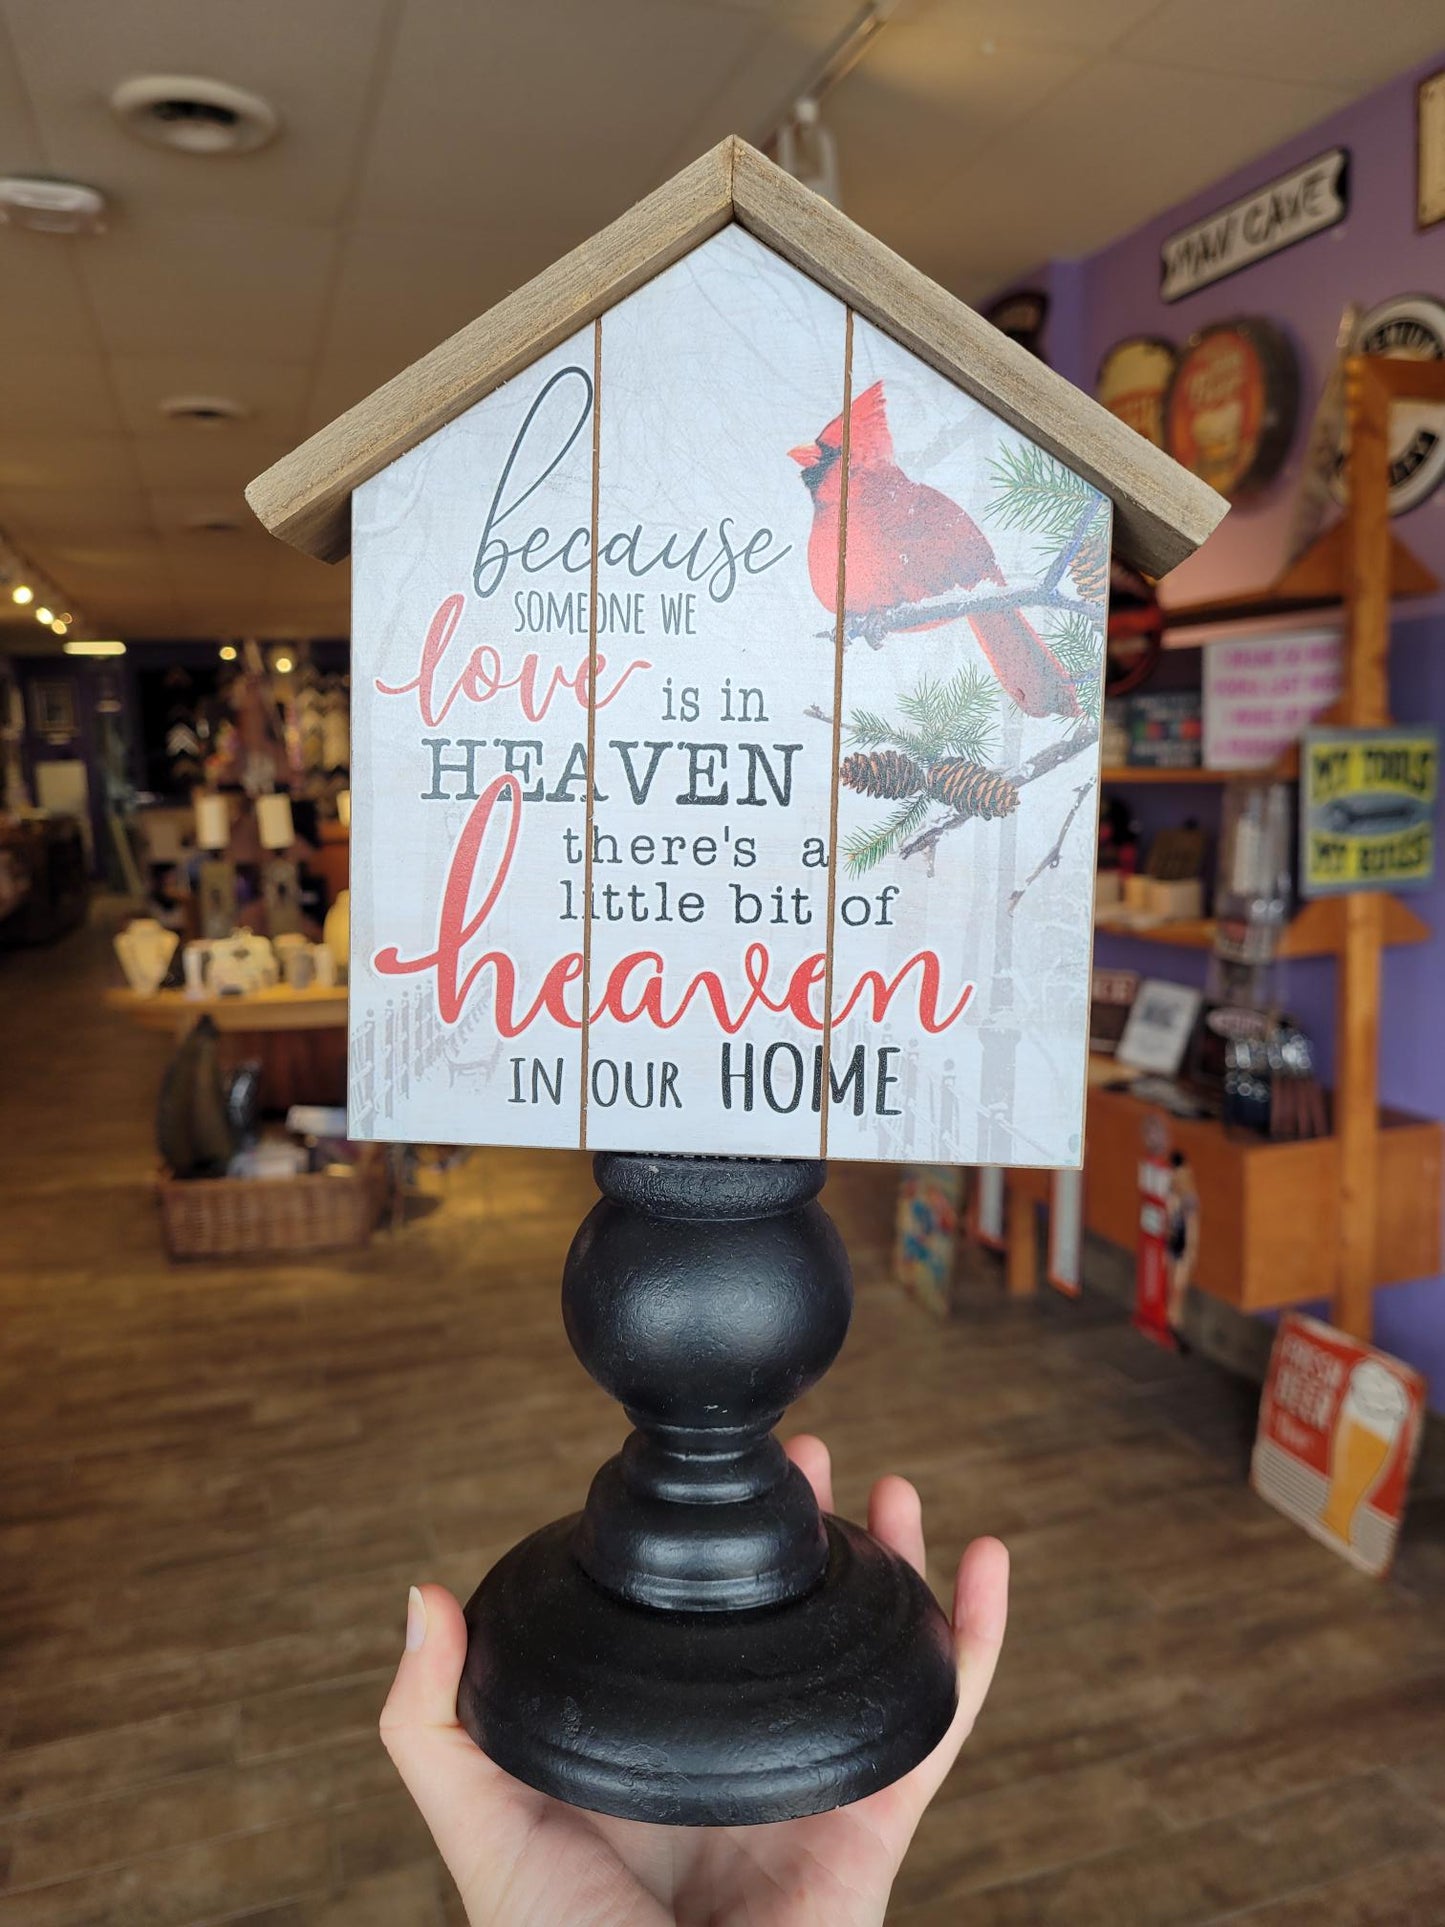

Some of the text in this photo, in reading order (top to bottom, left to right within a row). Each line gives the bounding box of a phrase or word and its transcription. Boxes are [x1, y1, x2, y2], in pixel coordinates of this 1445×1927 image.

[473, 365, 793, 604] because
[514, 592, 697, 637] SOMEONE WE
[376, 595, 769, 727] love is in
[421, 739, 804, 807] HEAVEN
[563, 825, 830, 868] there's a
[374, 774, 973, 1038] heaven
[559, 880, 900, 927] little bit of
[508, 1042, 903, 1117] IN OUR HOME
